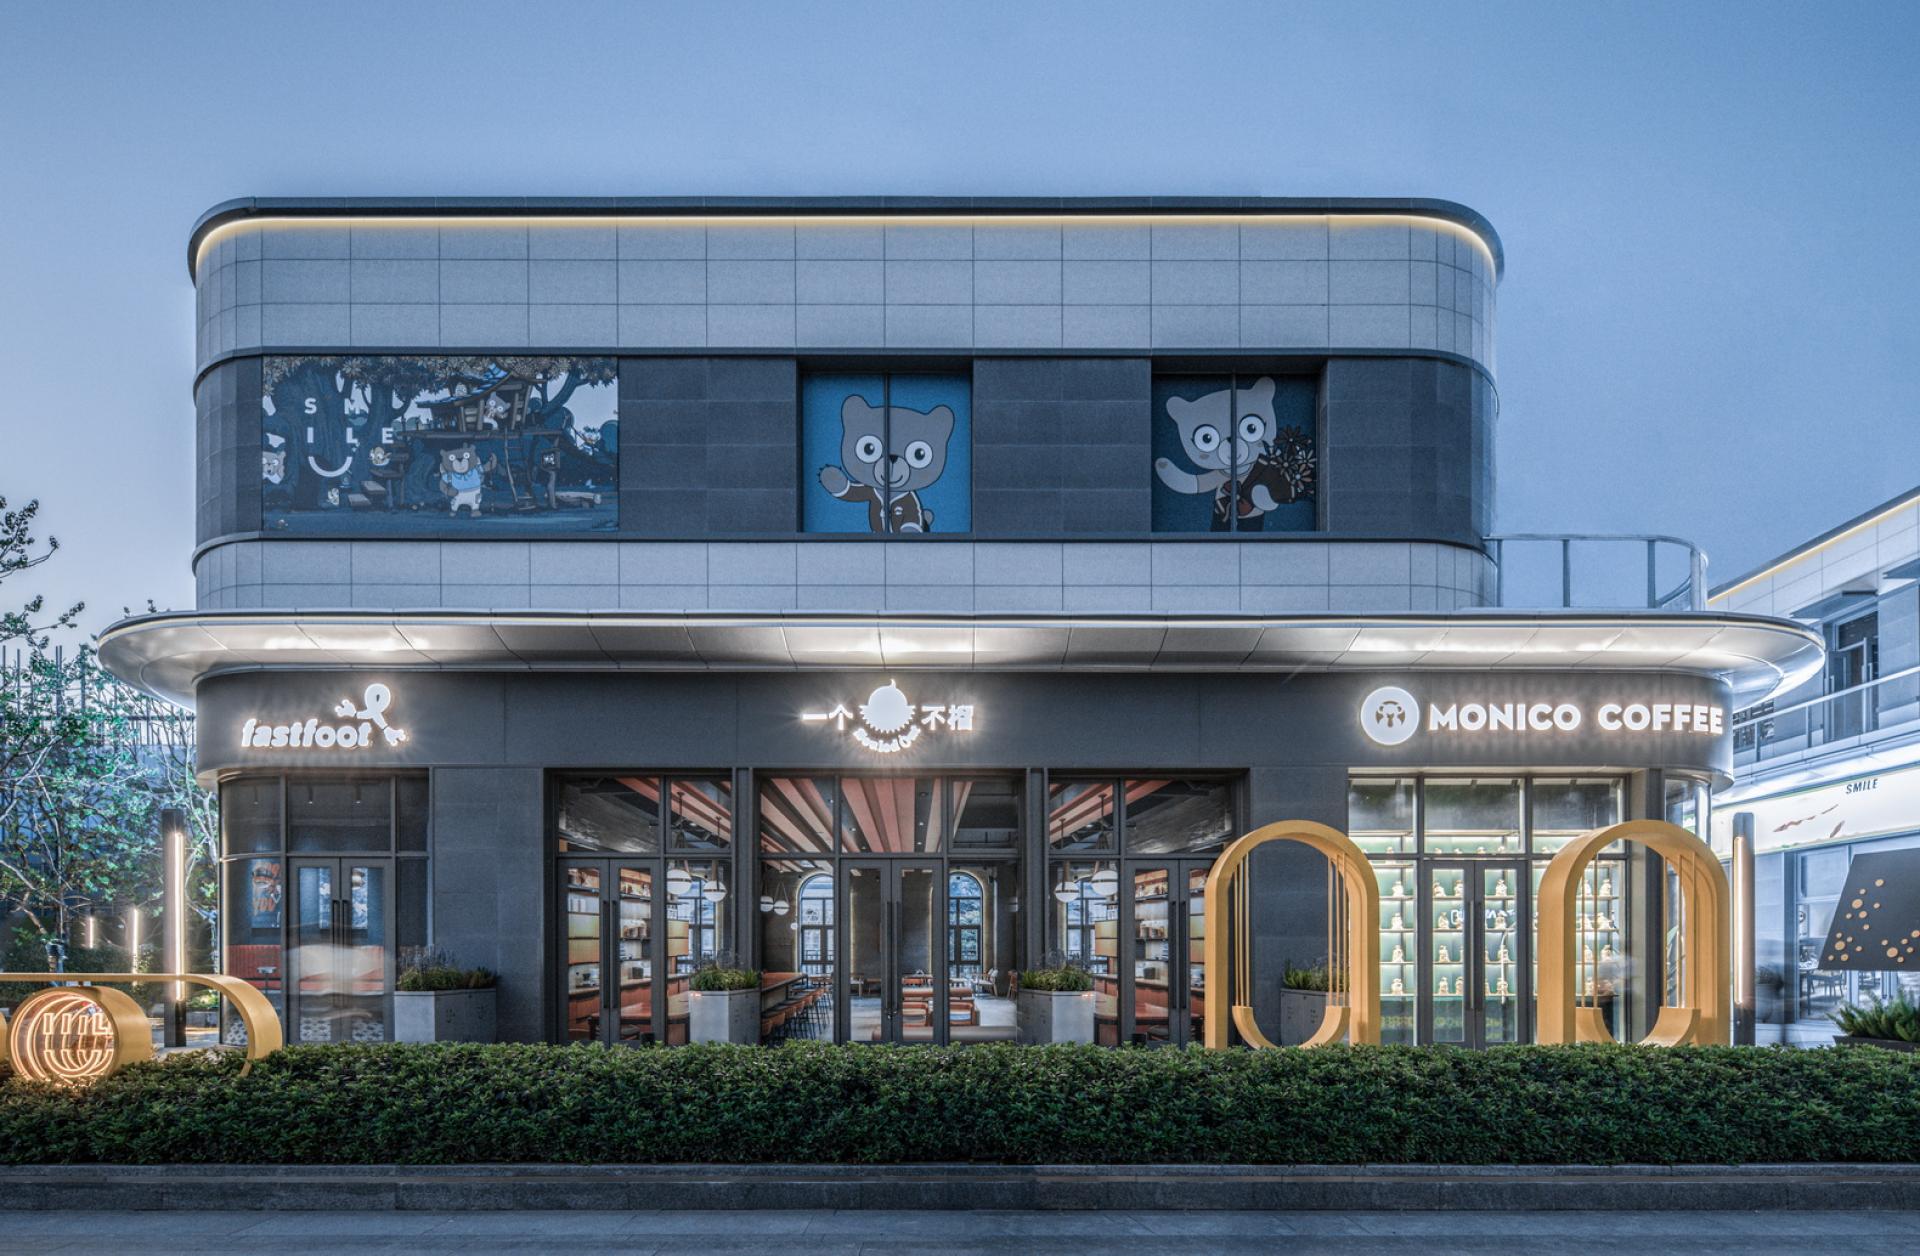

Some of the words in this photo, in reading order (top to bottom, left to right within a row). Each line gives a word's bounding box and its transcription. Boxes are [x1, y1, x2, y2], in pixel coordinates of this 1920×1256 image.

[1429, 703, 1581, 731] MONICO
[1598, 703, 1723, 734] COFFEE
[1845, 778, 1878, 794] SMILE
